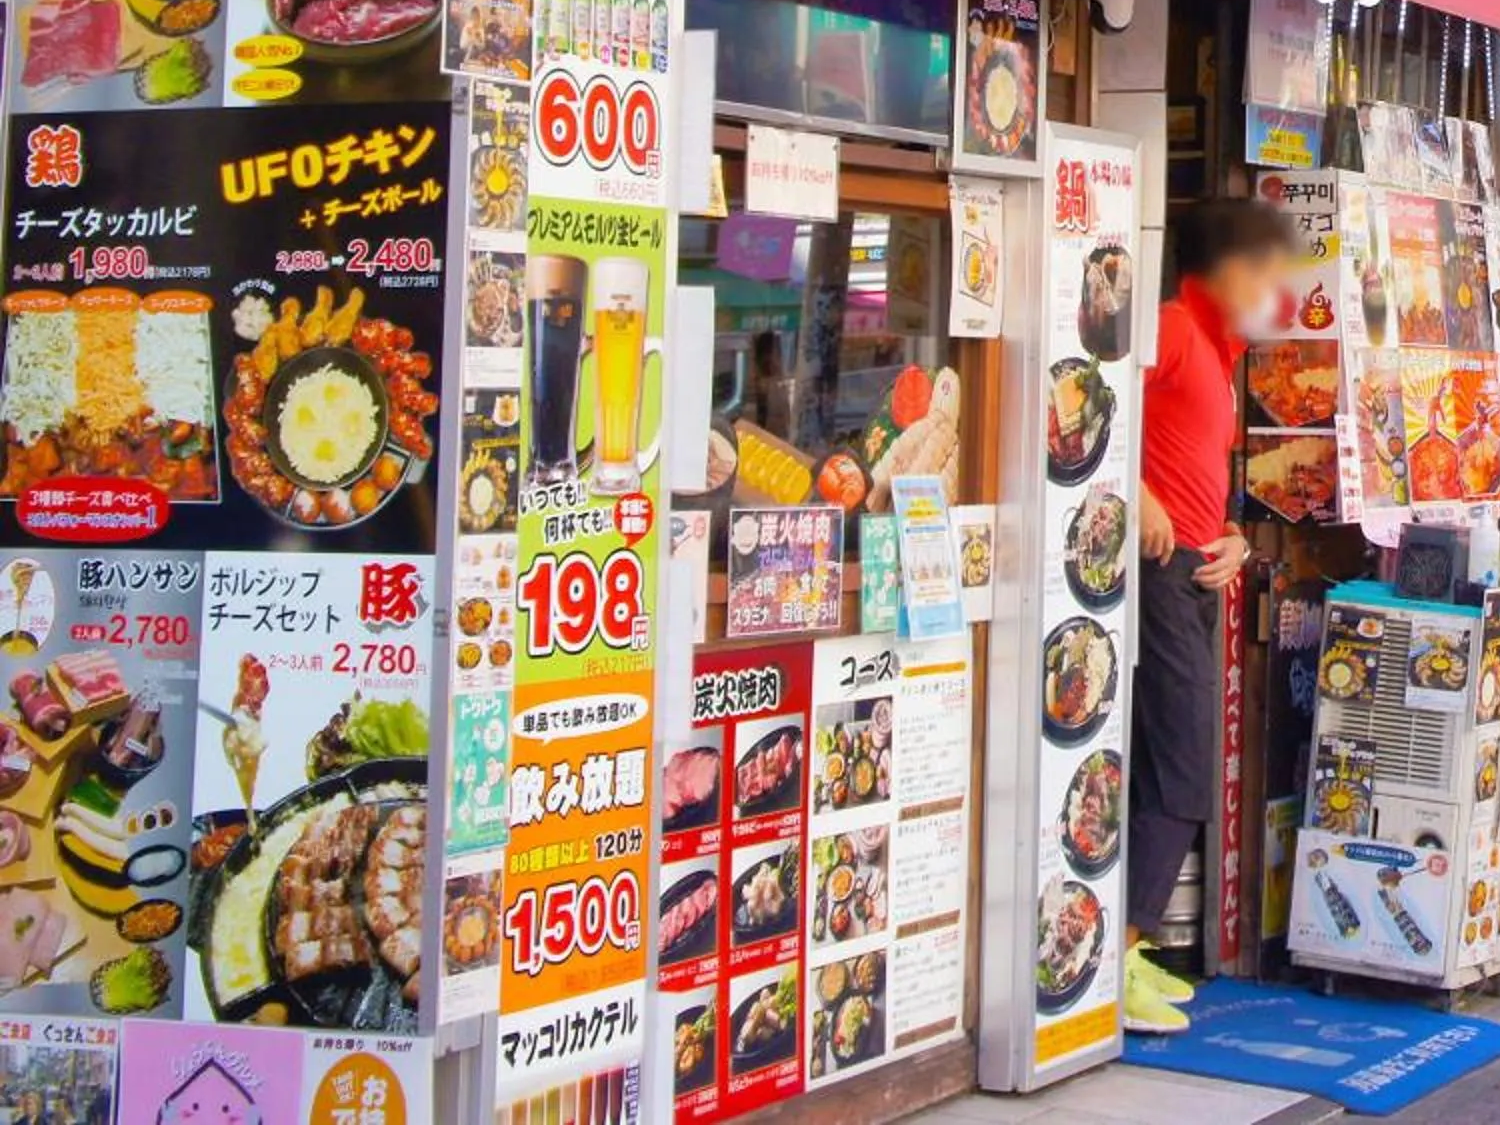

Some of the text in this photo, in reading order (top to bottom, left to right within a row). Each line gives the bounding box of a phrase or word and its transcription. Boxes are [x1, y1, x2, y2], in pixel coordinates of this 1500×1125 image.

[536, 69, 662, 179] 600円
[27, 126, 81, 187] 鶏
[220, 124, 437, 204] UFOチキン
[15, 205, 198, 239] チーズタッカルビ
[323, 178, 442, 226] チーズボール
[79, 559, 197, 592] 豚ハンサン
[359, 561, 418, 625] 豚
[209, 602, 340, 634] チーズセット
[839, 649, 896, 689] コース
[692, 670, 781, 721] 炭火焼肉
[511, 748, 647, 827] 飲み放題
[594, 828, 643, 860] 120分
[502, 996, 639, 1068] マッコリカクテル
